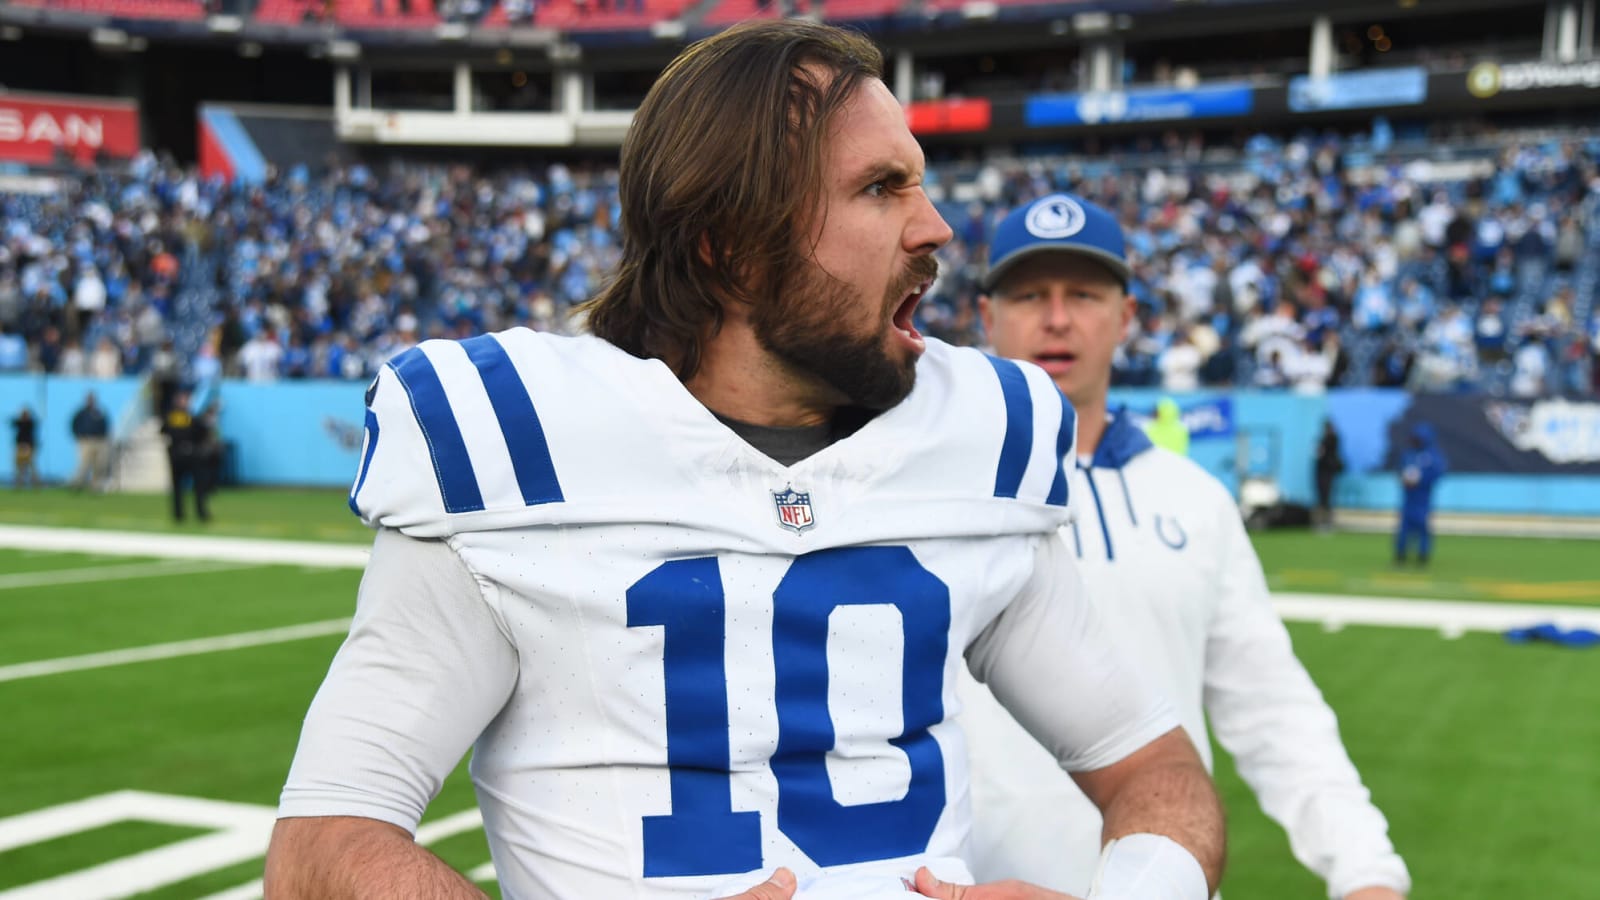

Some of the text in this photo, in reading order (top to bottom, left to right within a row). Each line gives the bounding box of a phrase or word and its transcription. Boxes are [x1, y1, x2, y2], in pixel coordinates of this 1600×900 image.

[0, 109, 103, 148] SAN
[780, 506, 811, 525] NFL
[626, 545, 951, 878] 10
